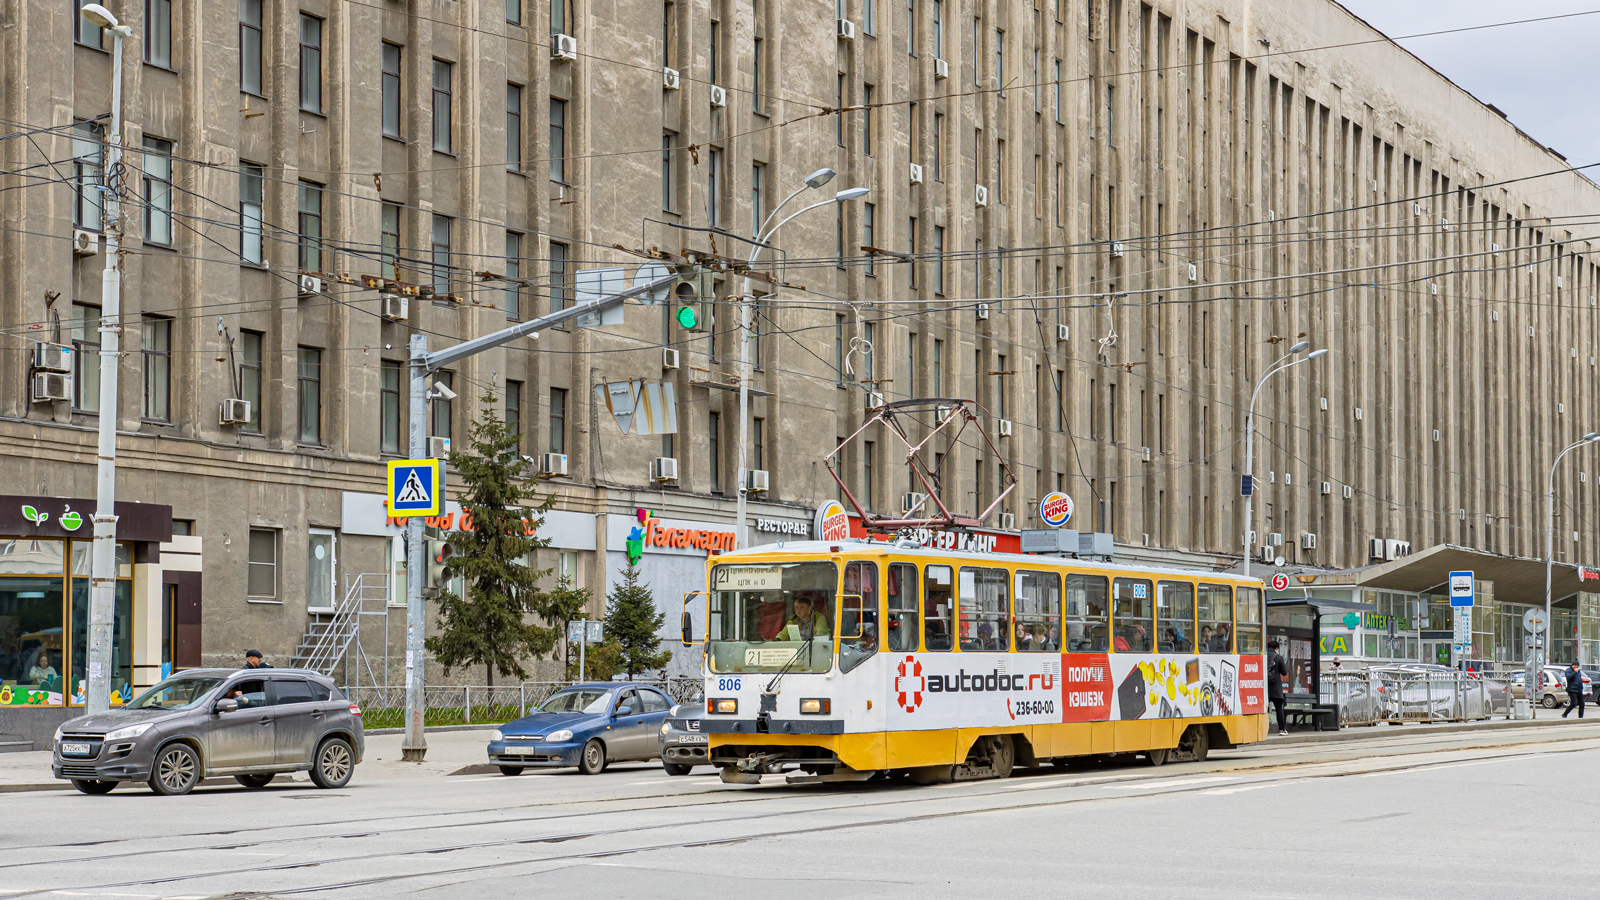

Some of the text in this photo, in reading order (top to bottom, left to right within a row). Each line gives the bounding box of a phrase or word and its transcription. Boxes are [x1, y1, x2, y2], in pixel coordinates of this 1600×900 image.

[1044, 498, 1067, 511] BURGER
[1045, 504, 1068, 519] KING
[757, 518, 808, 535] РЕСТОРАН
[823, 514, 846, 534] BURGER
[645, 518, 736, 557] Галамарт
[824, 524, 847, 541] KING
[718, 568, 729, 583] 21
[1135, 584, 1145, 597] 806
[1366, 613, 1392, 629] АПТЕК
[748, 651, 760, 665] 21
[1068, 666, 1104, 682] ПОЛУЧИ
[1244, 662, 1258, 672] СКАЧАЙ
[719, 678, 741, 691] 806
[928, 669, 1054, 692] autodoc.ru
[1240, 680, 1263, 688] ПРИЛОЖЕНИЕ
[1069, 691, 1105, 707] КЭШБЭК
[1246, 695, 1258, 706] ЗДЕСЬ
[1016, 700, 1054, 716] 236-60-00
